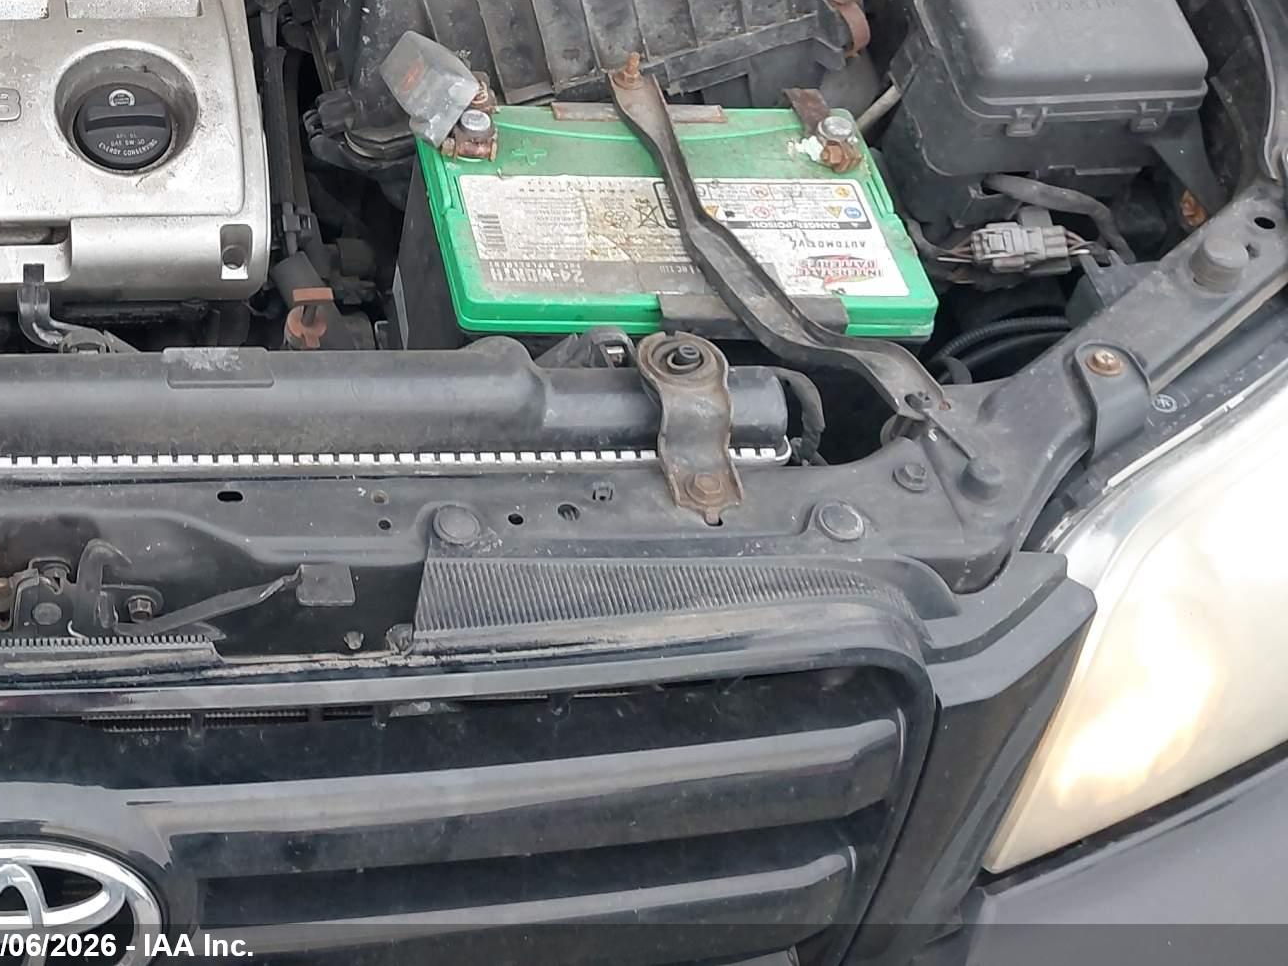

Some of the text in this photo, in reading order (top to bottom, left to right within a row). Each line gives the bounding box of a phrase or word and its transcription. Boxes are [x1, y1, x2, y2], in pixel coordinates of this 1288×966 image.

[792, 240, 866, 249] AUTOMOTIVE
[800, 260, 877, 269] BATTERIES
[489, 268, 585, 283] 24-MONTH
[797, 268, 883, 278] INTERSTATE
